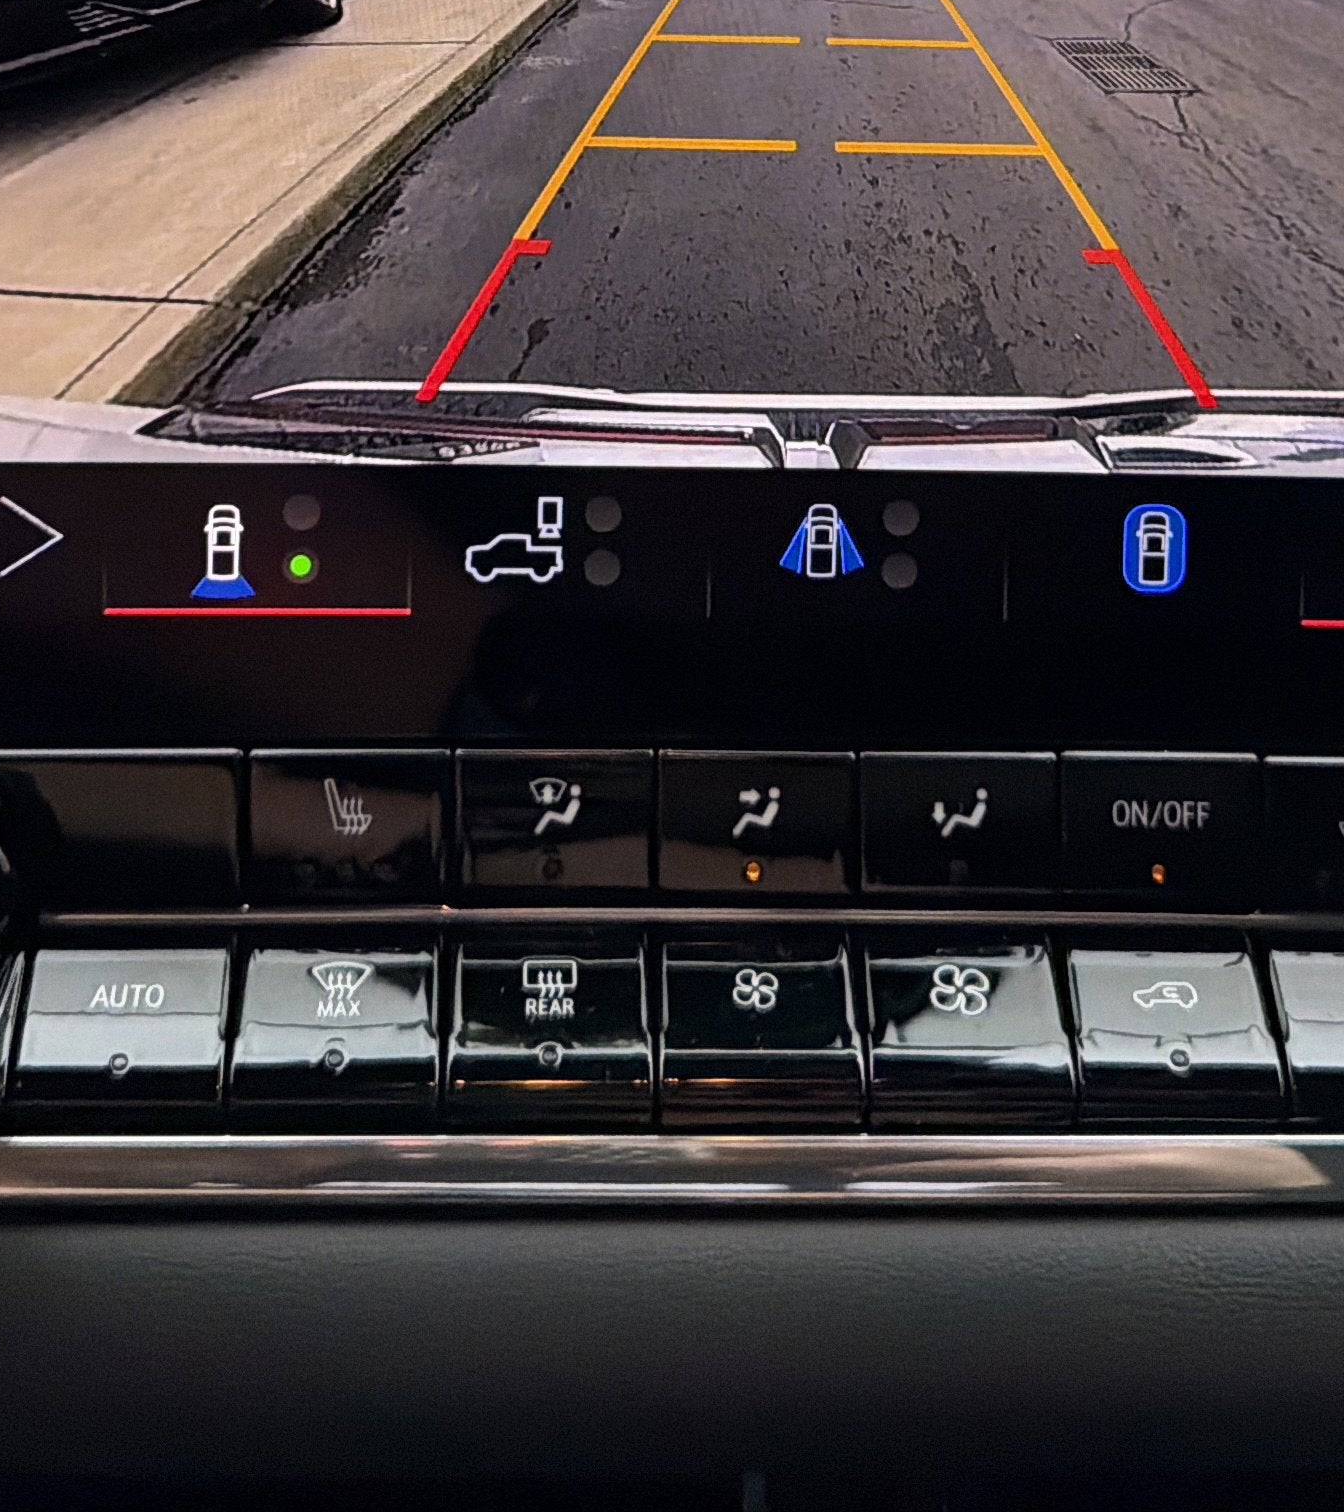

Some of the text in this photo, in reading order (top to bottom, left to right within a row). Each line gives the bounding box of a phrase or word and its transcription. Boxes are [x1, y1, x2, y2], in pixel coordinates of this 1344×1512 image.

[1111, 799, 1211, 828] ON/OFF
[88, 983, 165, 1009] AUTO
[524, 997, 576, 1017] REAR
[316, 999, 361, 1018] MAX
